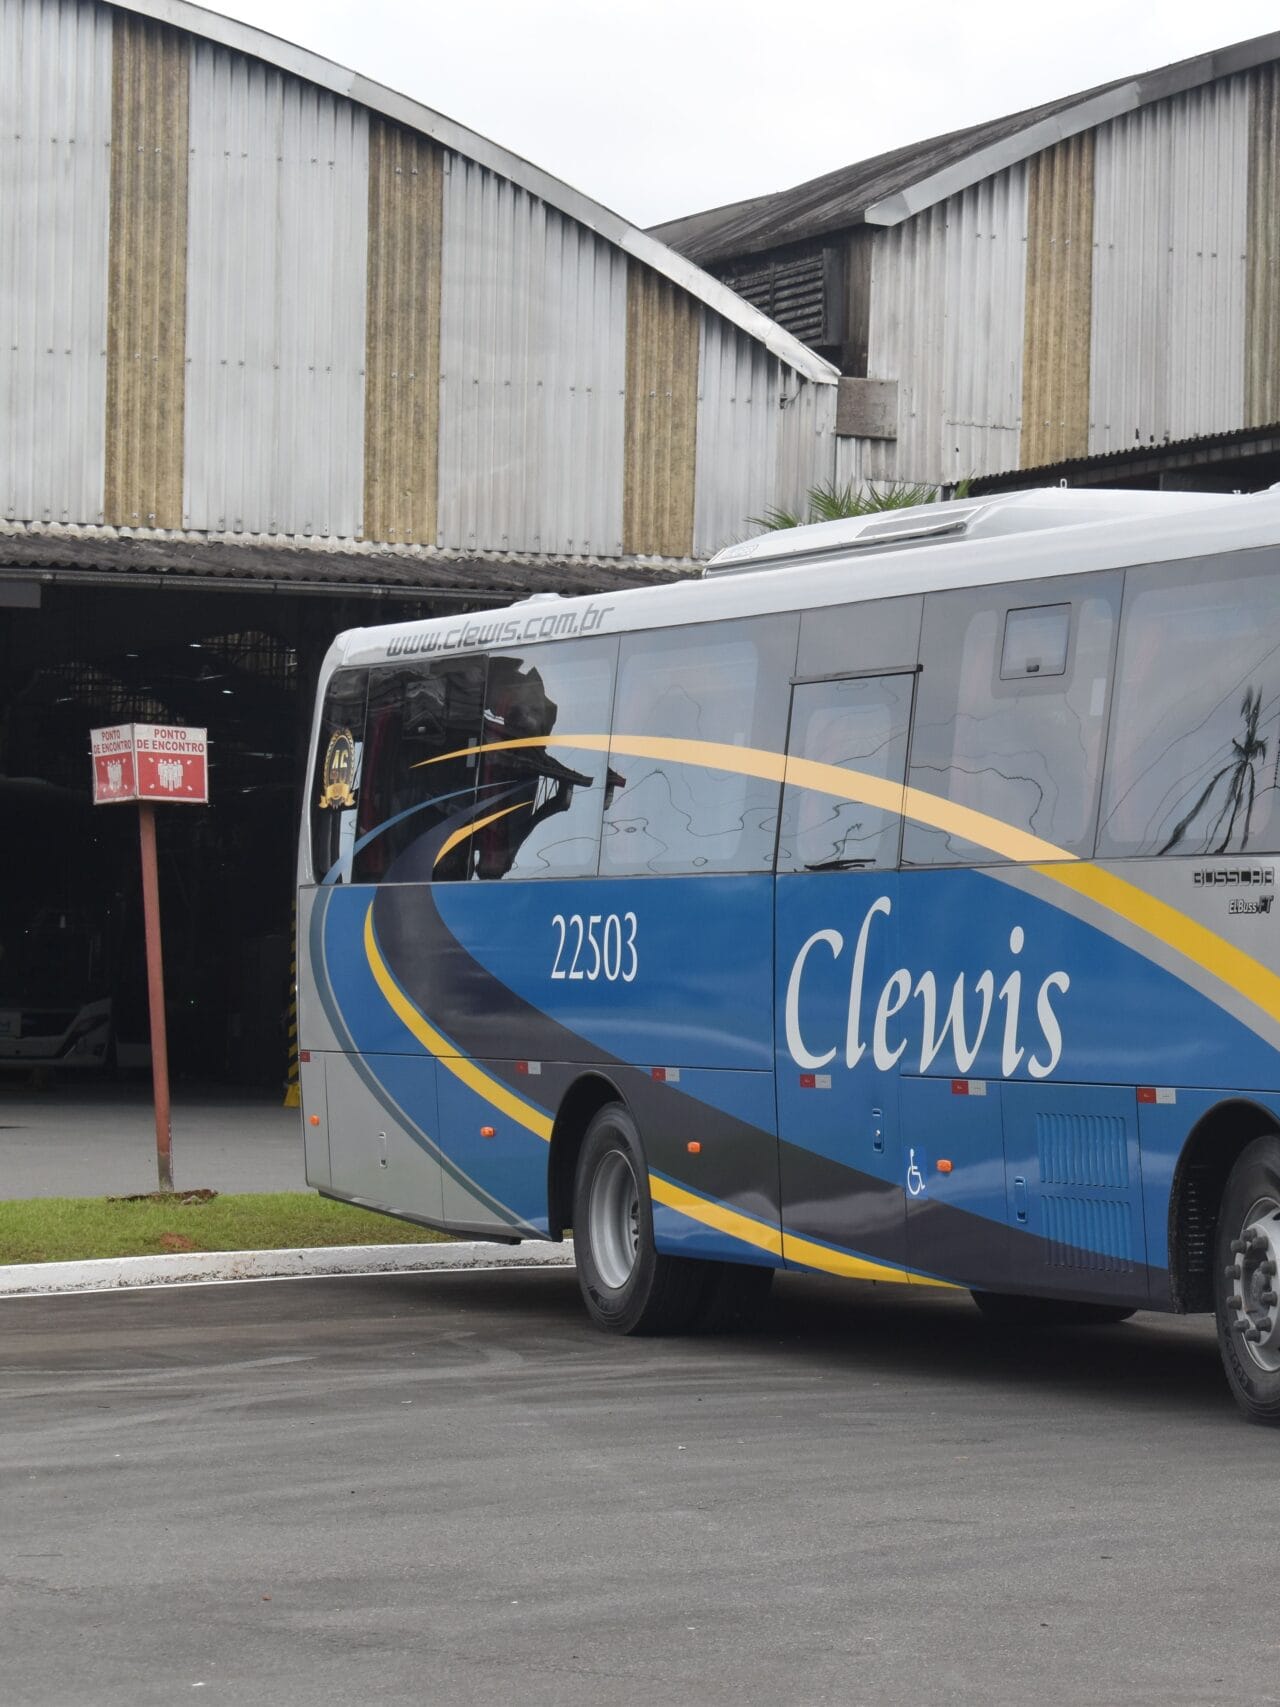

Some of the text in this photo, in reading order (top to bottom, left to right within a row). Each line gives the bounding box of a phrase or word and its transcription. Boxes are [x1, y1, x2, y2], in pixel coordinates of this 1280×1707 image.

[386, 602, 616, 657] www.clewis.com.br
[101, 729, 121, 741] PONTO
[154, 728, 187, 740] PONTO
[93, 740, 132, 754] DE ENCONTRO
[136, 739, 205, 753] DE ENCONTRO
[1192, 867, 1275, 887] BUSSCAR
[551, 911, 638, 982] 22503
[785, 895, 1071, 1078] Clewis
